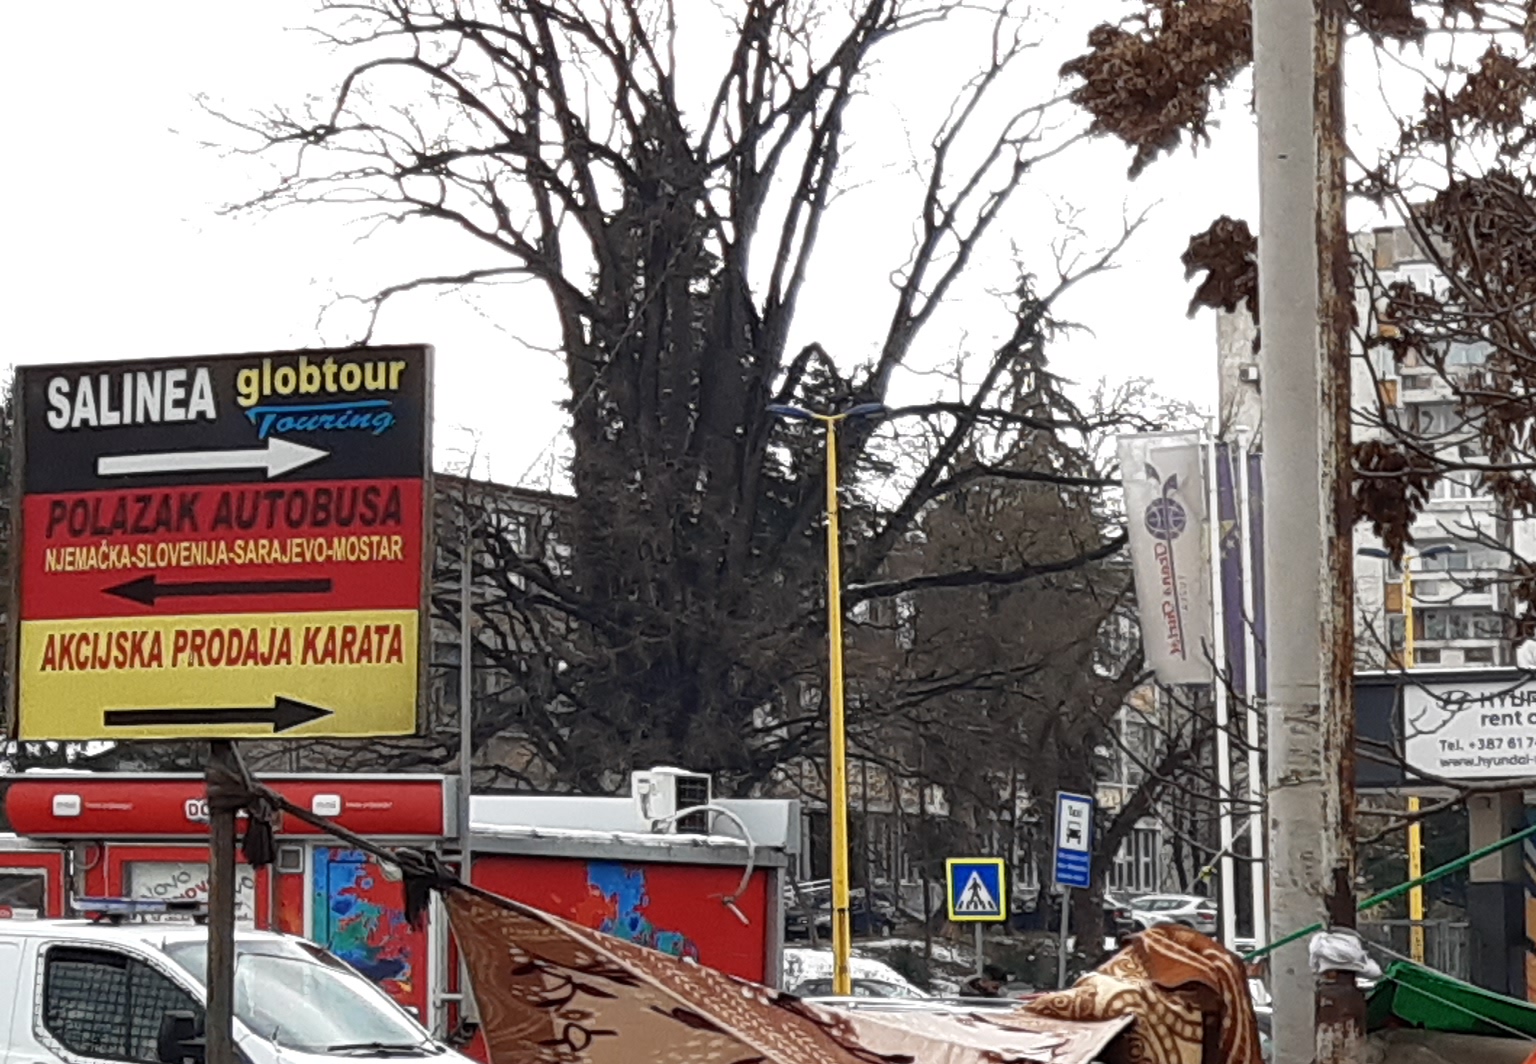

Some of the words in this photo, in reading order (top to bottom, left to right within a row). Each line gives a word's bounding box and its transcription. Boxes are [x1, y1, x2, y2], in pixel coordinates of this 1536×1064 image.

[47, 366, 217, 432] SALINEA
[236, 356, 406, 406] globtour
[245, 401, 397, 439] Touring
[45, 491, 199, 539] POLAZAK
[210, 484, 403, 532] AUTOBUSA
[44, 535, 404, 572] NJEMAČKA-SLOVENIJA-SARAJEVO-MOSTAR
[40, 627, 164, 673] AKCIJSKA
[171, 625, 293, 668] PRODAJA
[301, 623, 405, 665] KARATA
[1480, 710, 1523, 727] rent
[1439, 739, 1464, 752] Tel.
[1469, 737, 1504, 751] +387
[1507, 736, 1523, 750] 61
